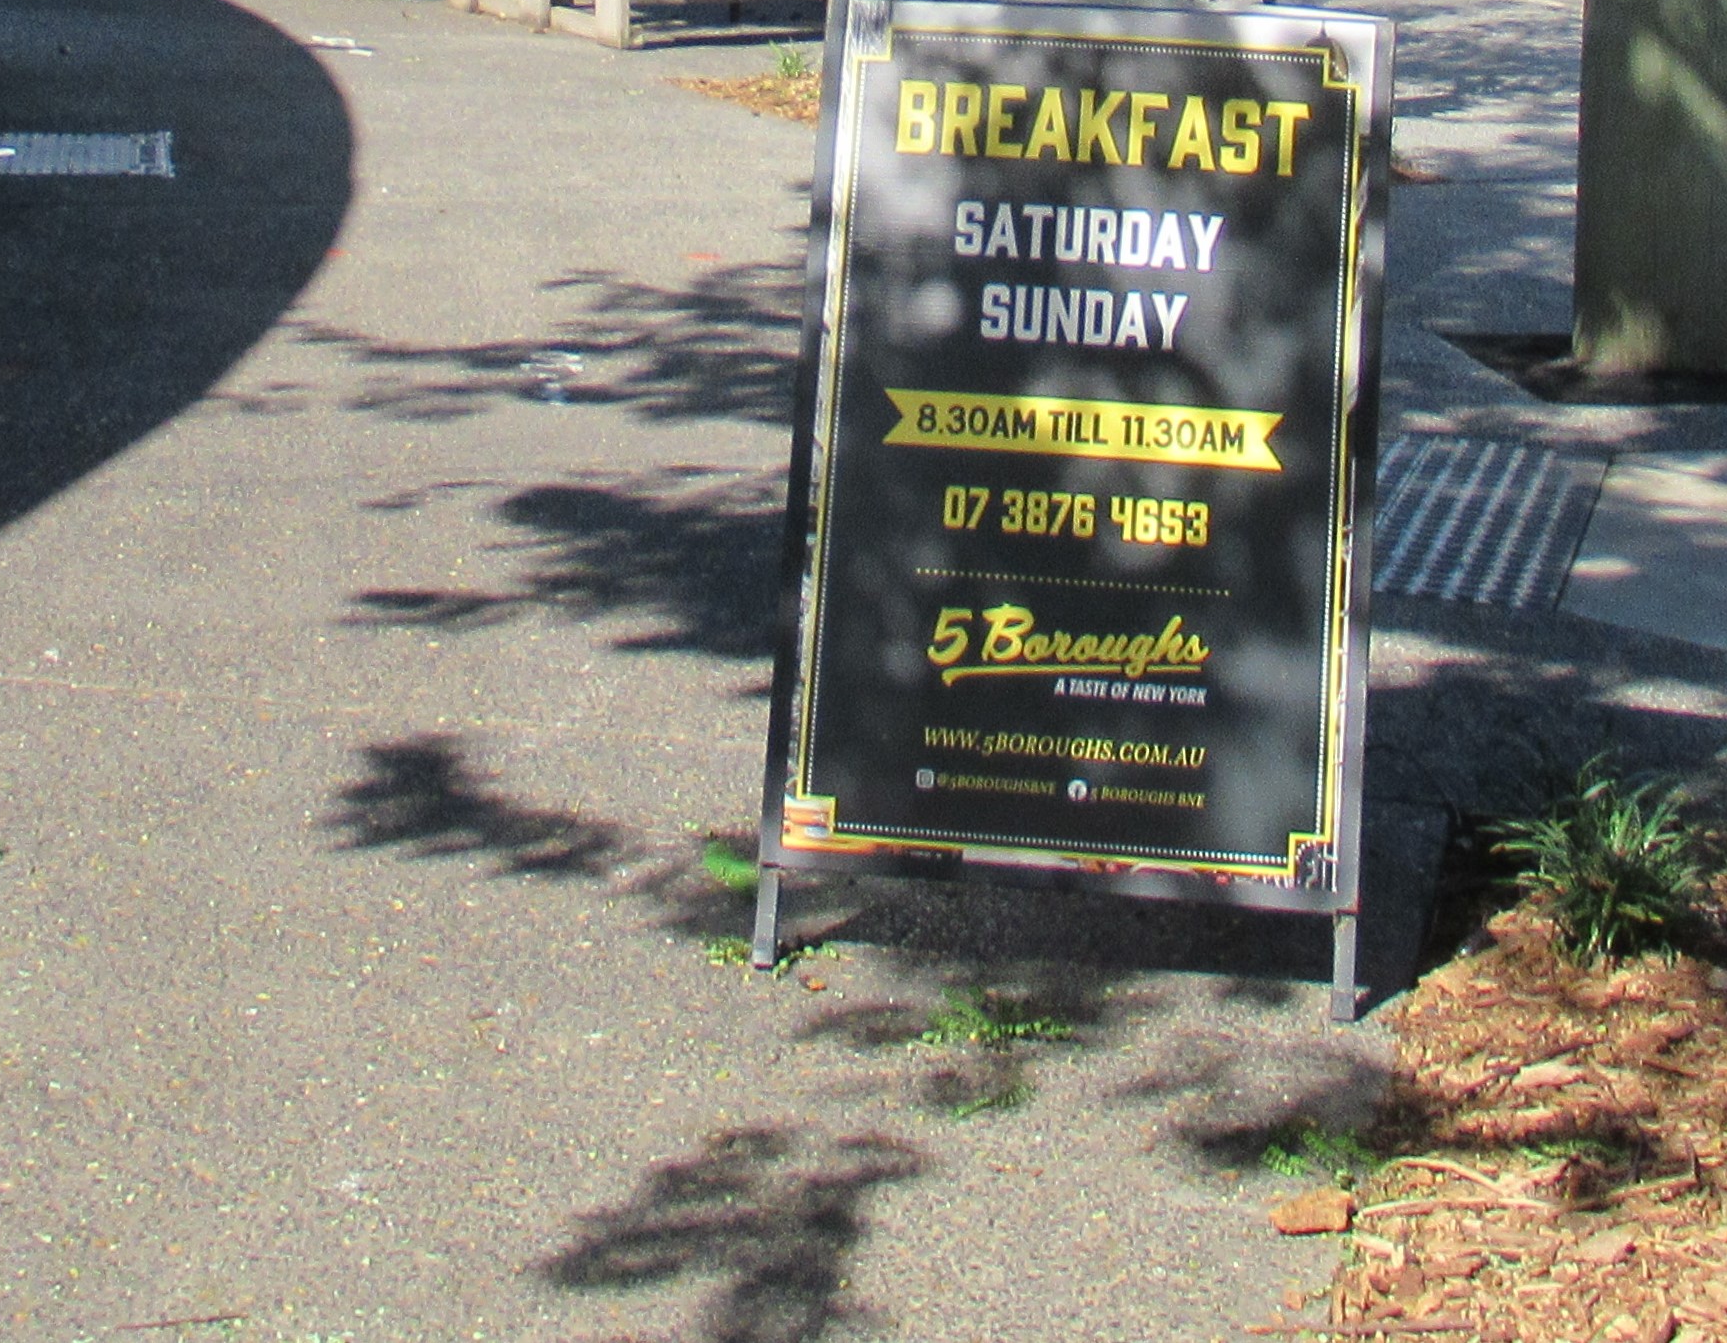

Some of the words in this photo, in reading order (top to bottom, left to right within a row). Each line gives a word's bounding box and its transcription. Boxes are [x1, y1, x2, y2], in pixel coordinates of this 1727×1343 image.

[895, 79, 1312, 177] BREAKFAST
[954, 200, 1226, 273] SATURDAY
[980, 282, 1189, 351] SUNDAY
[916, 403, 1037, 441] 8.30AM
[1048, 410, 1109, 446] TILL
[1121, 415, 1245, 455] 11.30AM
[943, 485, 990, 530] 07
[1001, 488, 1096, 539] 3876
[1110, 495, 1210, 547] 4653
[927, 607, 973, 666] 5
[980, 603, 1210, 679] Boroughs
[1054, 677, 1065, 696] A
[1069, 678, 1108, 698] TASTE
[1111, 681, 1130, 700] OF
[1133, 683, 1166, 702] NEW
[1169, 686, 1208, 706] YORK
